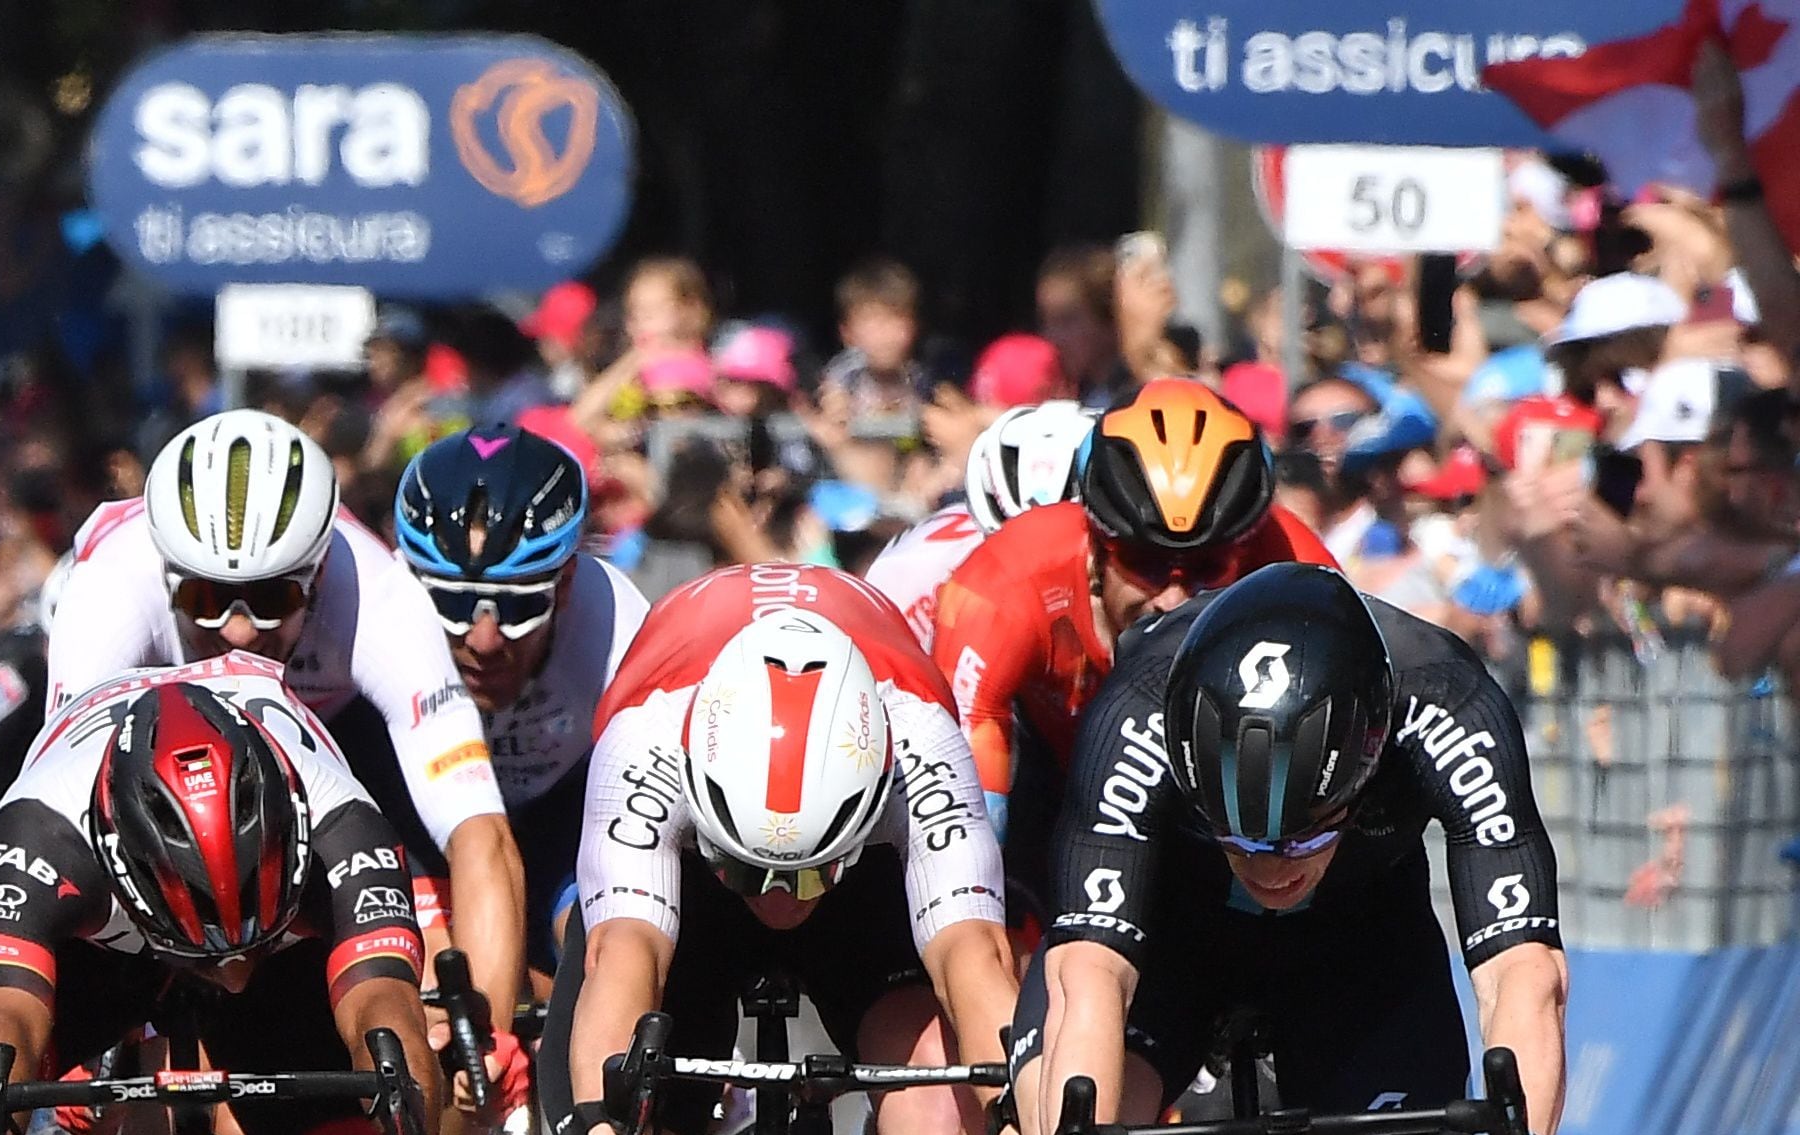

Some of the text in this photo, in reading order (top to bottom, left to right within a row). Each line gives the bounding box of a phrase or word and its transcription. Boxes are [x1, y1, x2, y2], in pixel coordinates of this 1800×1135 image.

[1166, 17, 1228, 91] ti
[134, 80, 430, 188] sara
[1349, 174, 1427, 231] 50
[135, 203, 431, 264] ti assicura
[706, 698, 723, 763] Cofidis
[856, 691, 869, 751] Cofidis
[183, 771, 214, 787] UAE
[1316, 749, 1340, 797] youfone
[1051, 913, 1147, 942] SCOTT
[1466, 916, 1560, 950] SCOTT
